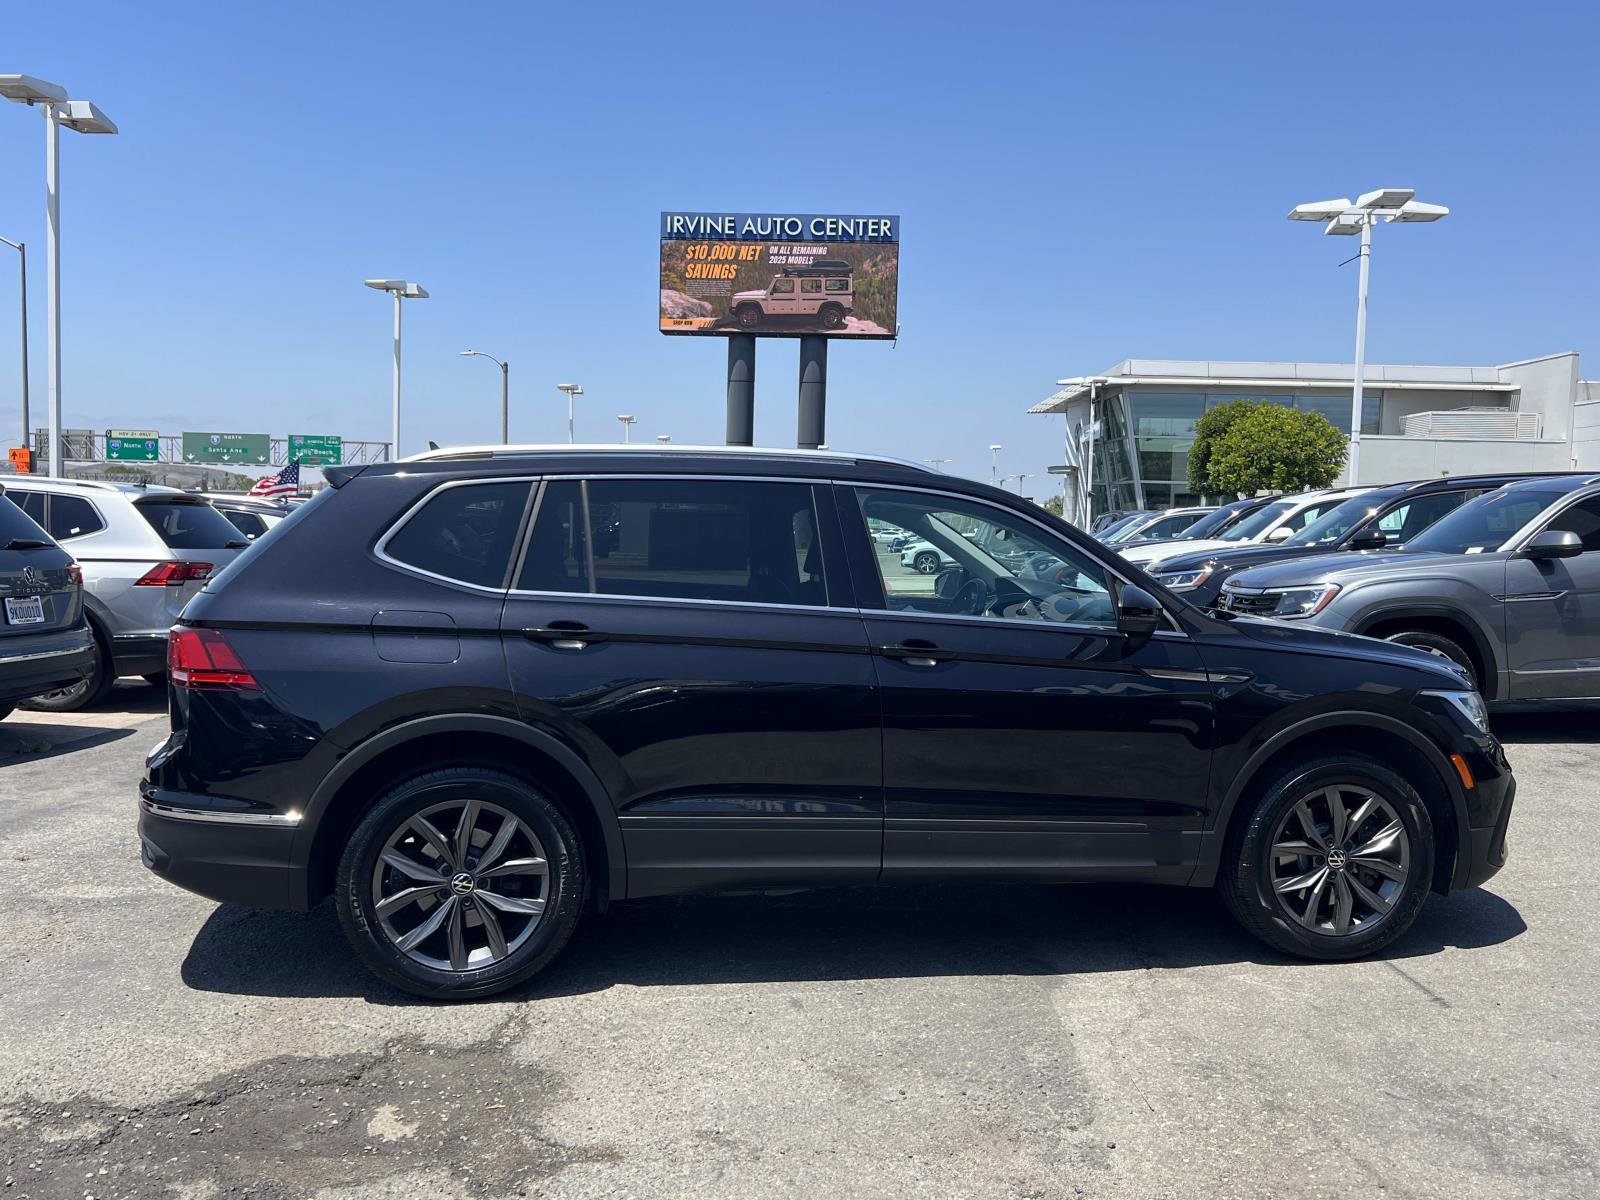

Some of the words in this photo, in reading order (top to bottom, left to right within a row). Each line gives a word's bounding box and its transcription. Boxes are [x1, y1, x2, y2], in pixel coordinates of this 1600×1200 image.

[667, 215, 735, 235] IRVINE
[742, 217, 802, 236] AUTO
[809, 218, 892, 237] CENTER
[685, 244, 737, 261] $10,000
[738, 245, 763, 260] NET
[769, 245, 779, 254] ON
[779, 246, 791, 255] ALL
[792, 246, 828, 255] REMAINING
[768, 255, 787, 264] 2025
[787, 256, 814, 265] MODELS
[685, 263, 738, 279] SAVINGS
